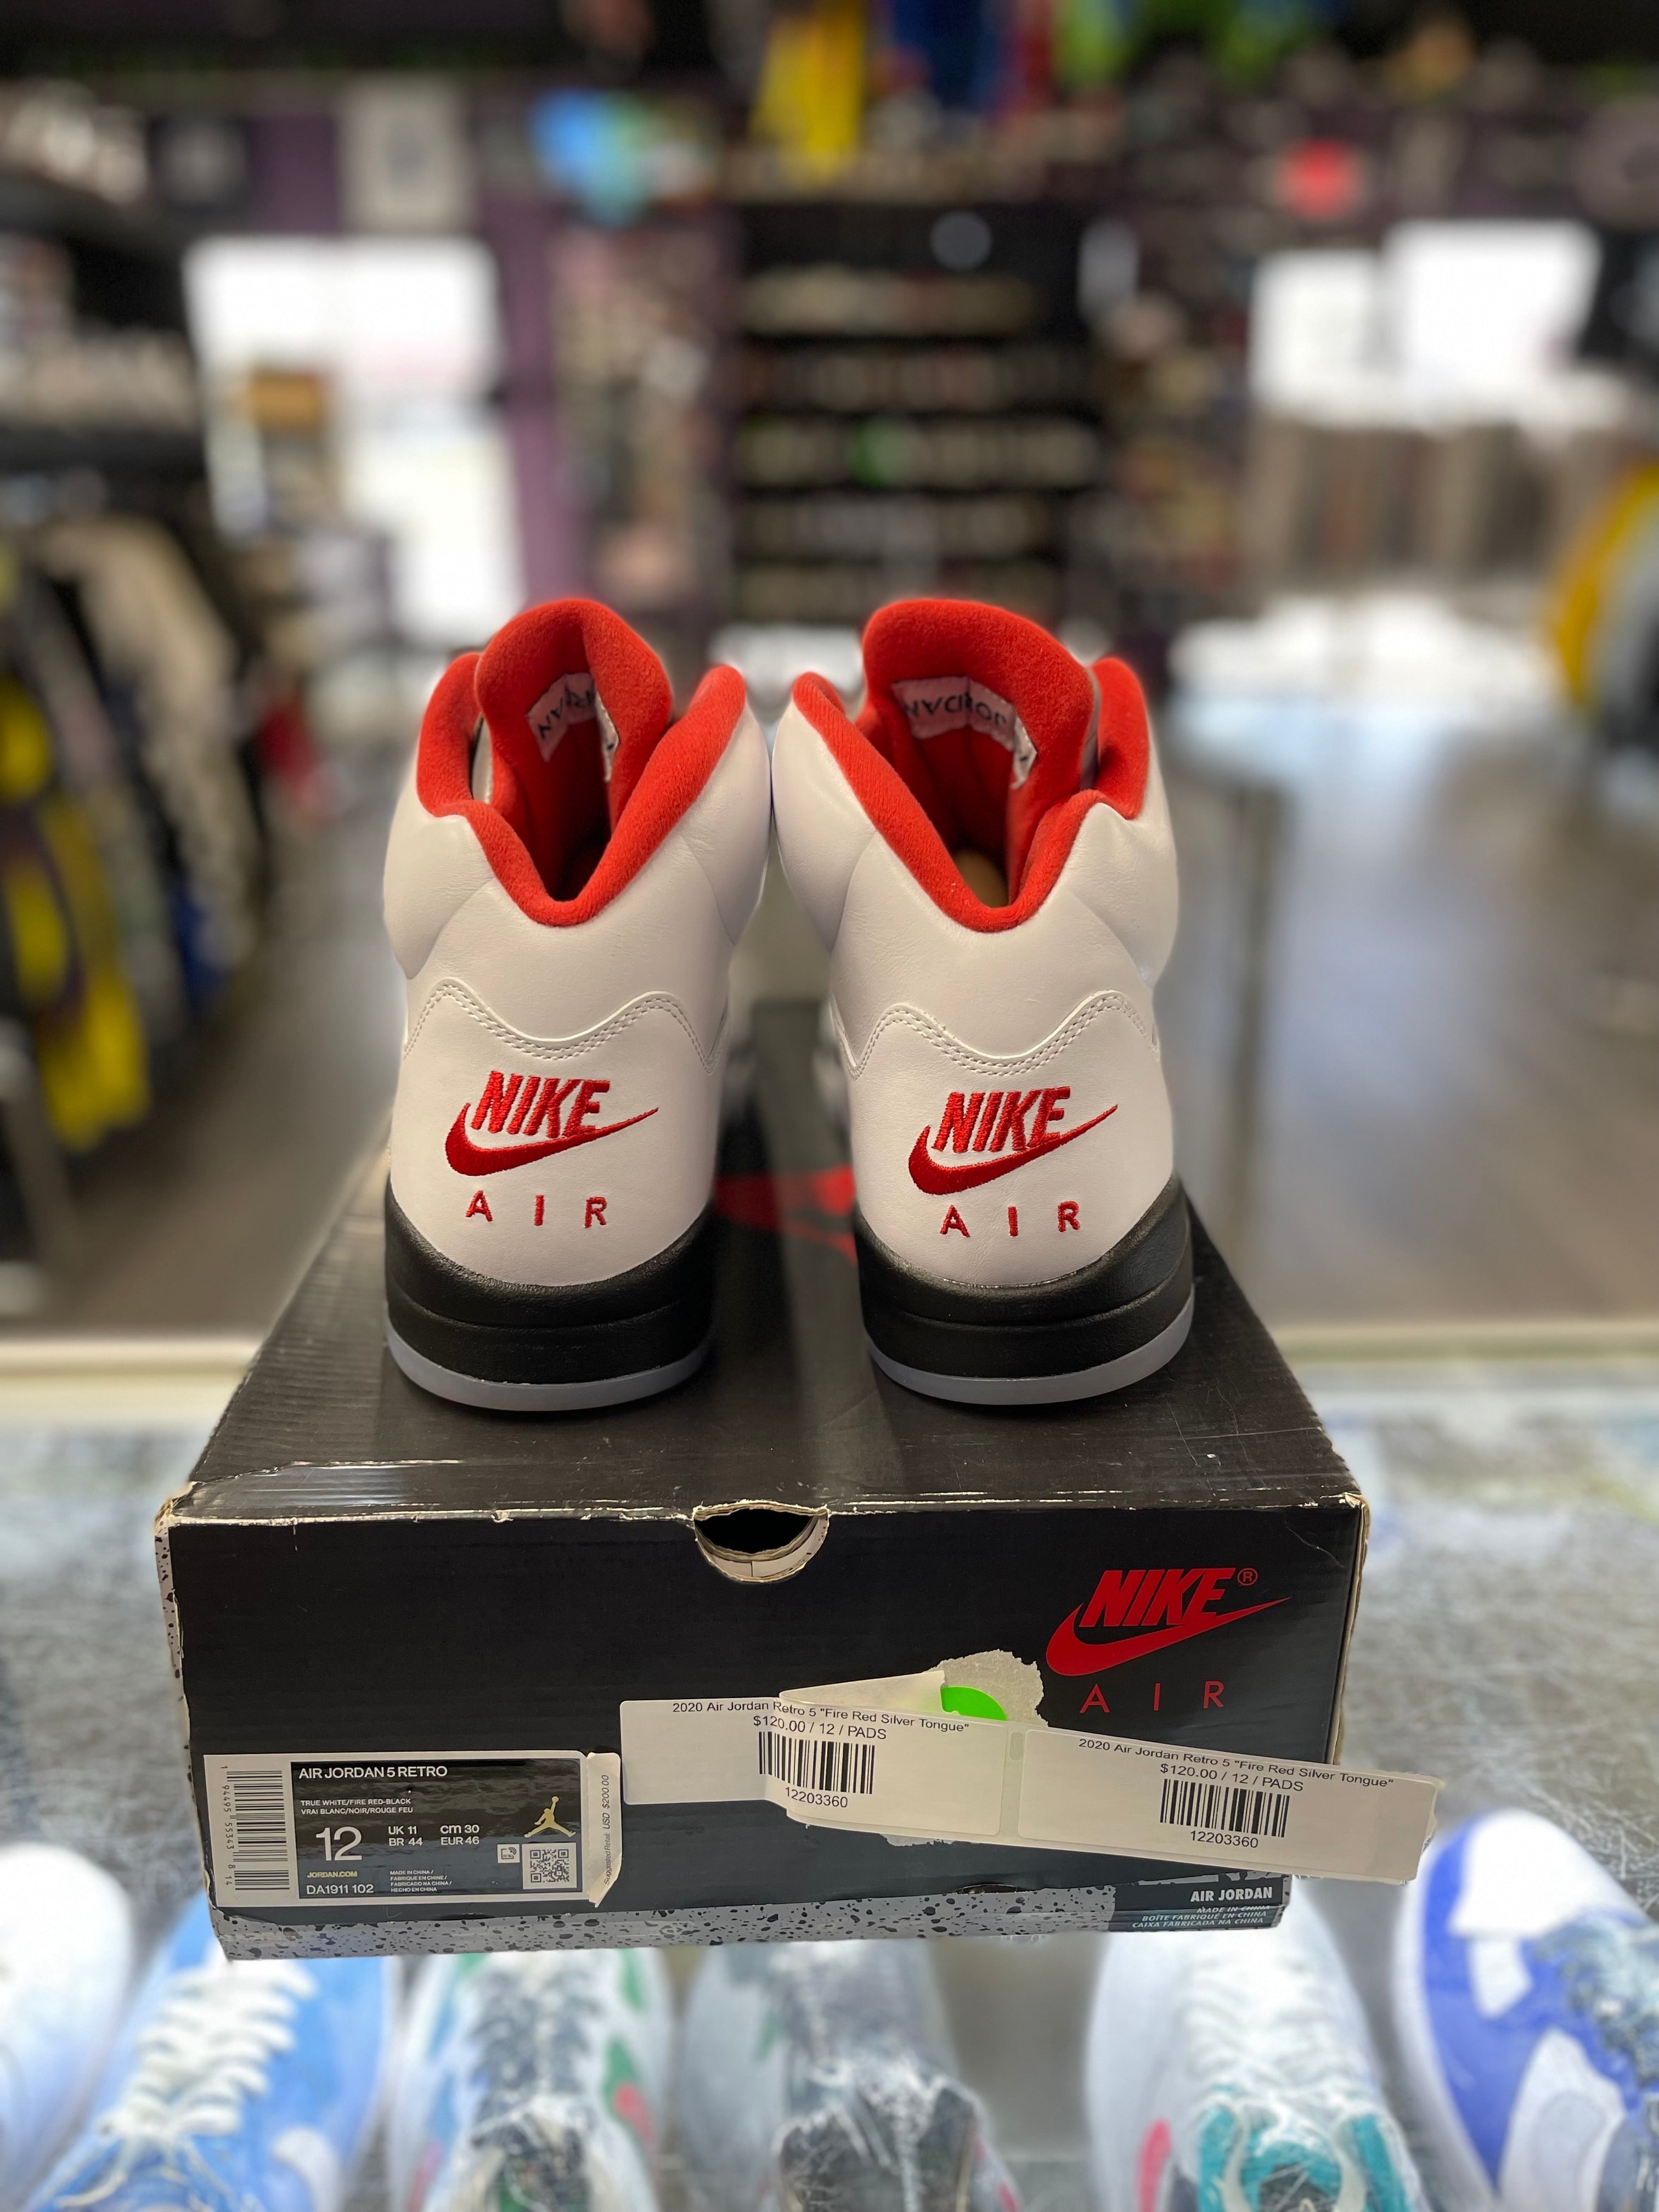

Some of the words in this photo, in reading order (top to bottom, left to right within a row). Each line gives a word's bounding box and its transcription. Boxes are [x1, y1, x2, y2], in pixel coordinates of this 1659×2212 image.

[471, 1070, 610, 1138] NIKE
[932, 1086, 1071, 1153] NIKE
[465, 1190, 607, 1228] AIR
[940, 1201, 1081, 1237] AIR
[1079, 1567, 1236, 1627] NIKE
[1080, 1680, 1224, 1713] AIR
[673, 1702, 703, 1712] 2020
[707, 1702, 724, 1711] Air
[727, 1701, 768, 1711] Jordan
[773, 1701, 805, 1716] Retro
[809, 1708, 816, 1717] 5
[820, 1708, 848, 1719] "Fire
[853, 1711, 877, 1722] Red
[881, 1714, 915, 1726] Silver
[919, 1718, 969, 1732] Tongue"
[753, 1716, 805, 1733] $120.00
[819, 1723, 835, 1735] 12
[848, 1725, 887, 1740] PADS
[298, 1768, 323, 1779] AIR
[324, 1767, 385, 1779] JORDAN
[387, 1767, 396, 1778] 5
[398, 1766, 448, 1778] RETRO
[1079, 1739, 1110, 1751] 2020
[1114, 1744, 1132, 1754] Air
[1135, 1747, 1179, 1760] Jordan
[1183, 1753, 1218, 1765] Retro
[1222, 1759, 1230, 1767] 5
[1234, 1760, 1264, 1771] "Fire
[1268, 1765, 1295, 1775] Red
[1299, 1768, 1336, 1780] Silver
[1340, 1773, 1394, 1787] Tongue"
[1160, 1763, 1217, 1780] $120.00
[1232, 1773, 1249, 1784] 12
[1262, 1777, 1304, 1791] PADS
[222, 1785, 231, 1812] 94495
[602, 1775, 610, 1809] $200.00
[786, 1787, 848, 1808] 12203360
[225, 1822, 234, 1849] 55343
[388, 1826, 404, 1835] UK
[408, 1826, 417, 1834] 11
[388, 1837, 404, 1847] BR
[408, 1837, 423, 1846] 44
[440, 1825, 461, 1834] cm
[464, 1824, 479, 1833] 30
[441, 1837, 463, 1846] EUR
[465, 1836, 479, 1845] 46
[1190, 1830, 1259, 1848] 12203360
[315, 1826, 362, 1861] 12
[224, 1876, 233, 1885] 14
[604, 1851, 612, 1886] Suggested
[307, 1884, 349, 1894] DA1911
[352, 1884, 374, 1893] 102
[1190, 1890, 1215, 1902] AIR
[1218, 1887, 1273, 1901] JORDAN
